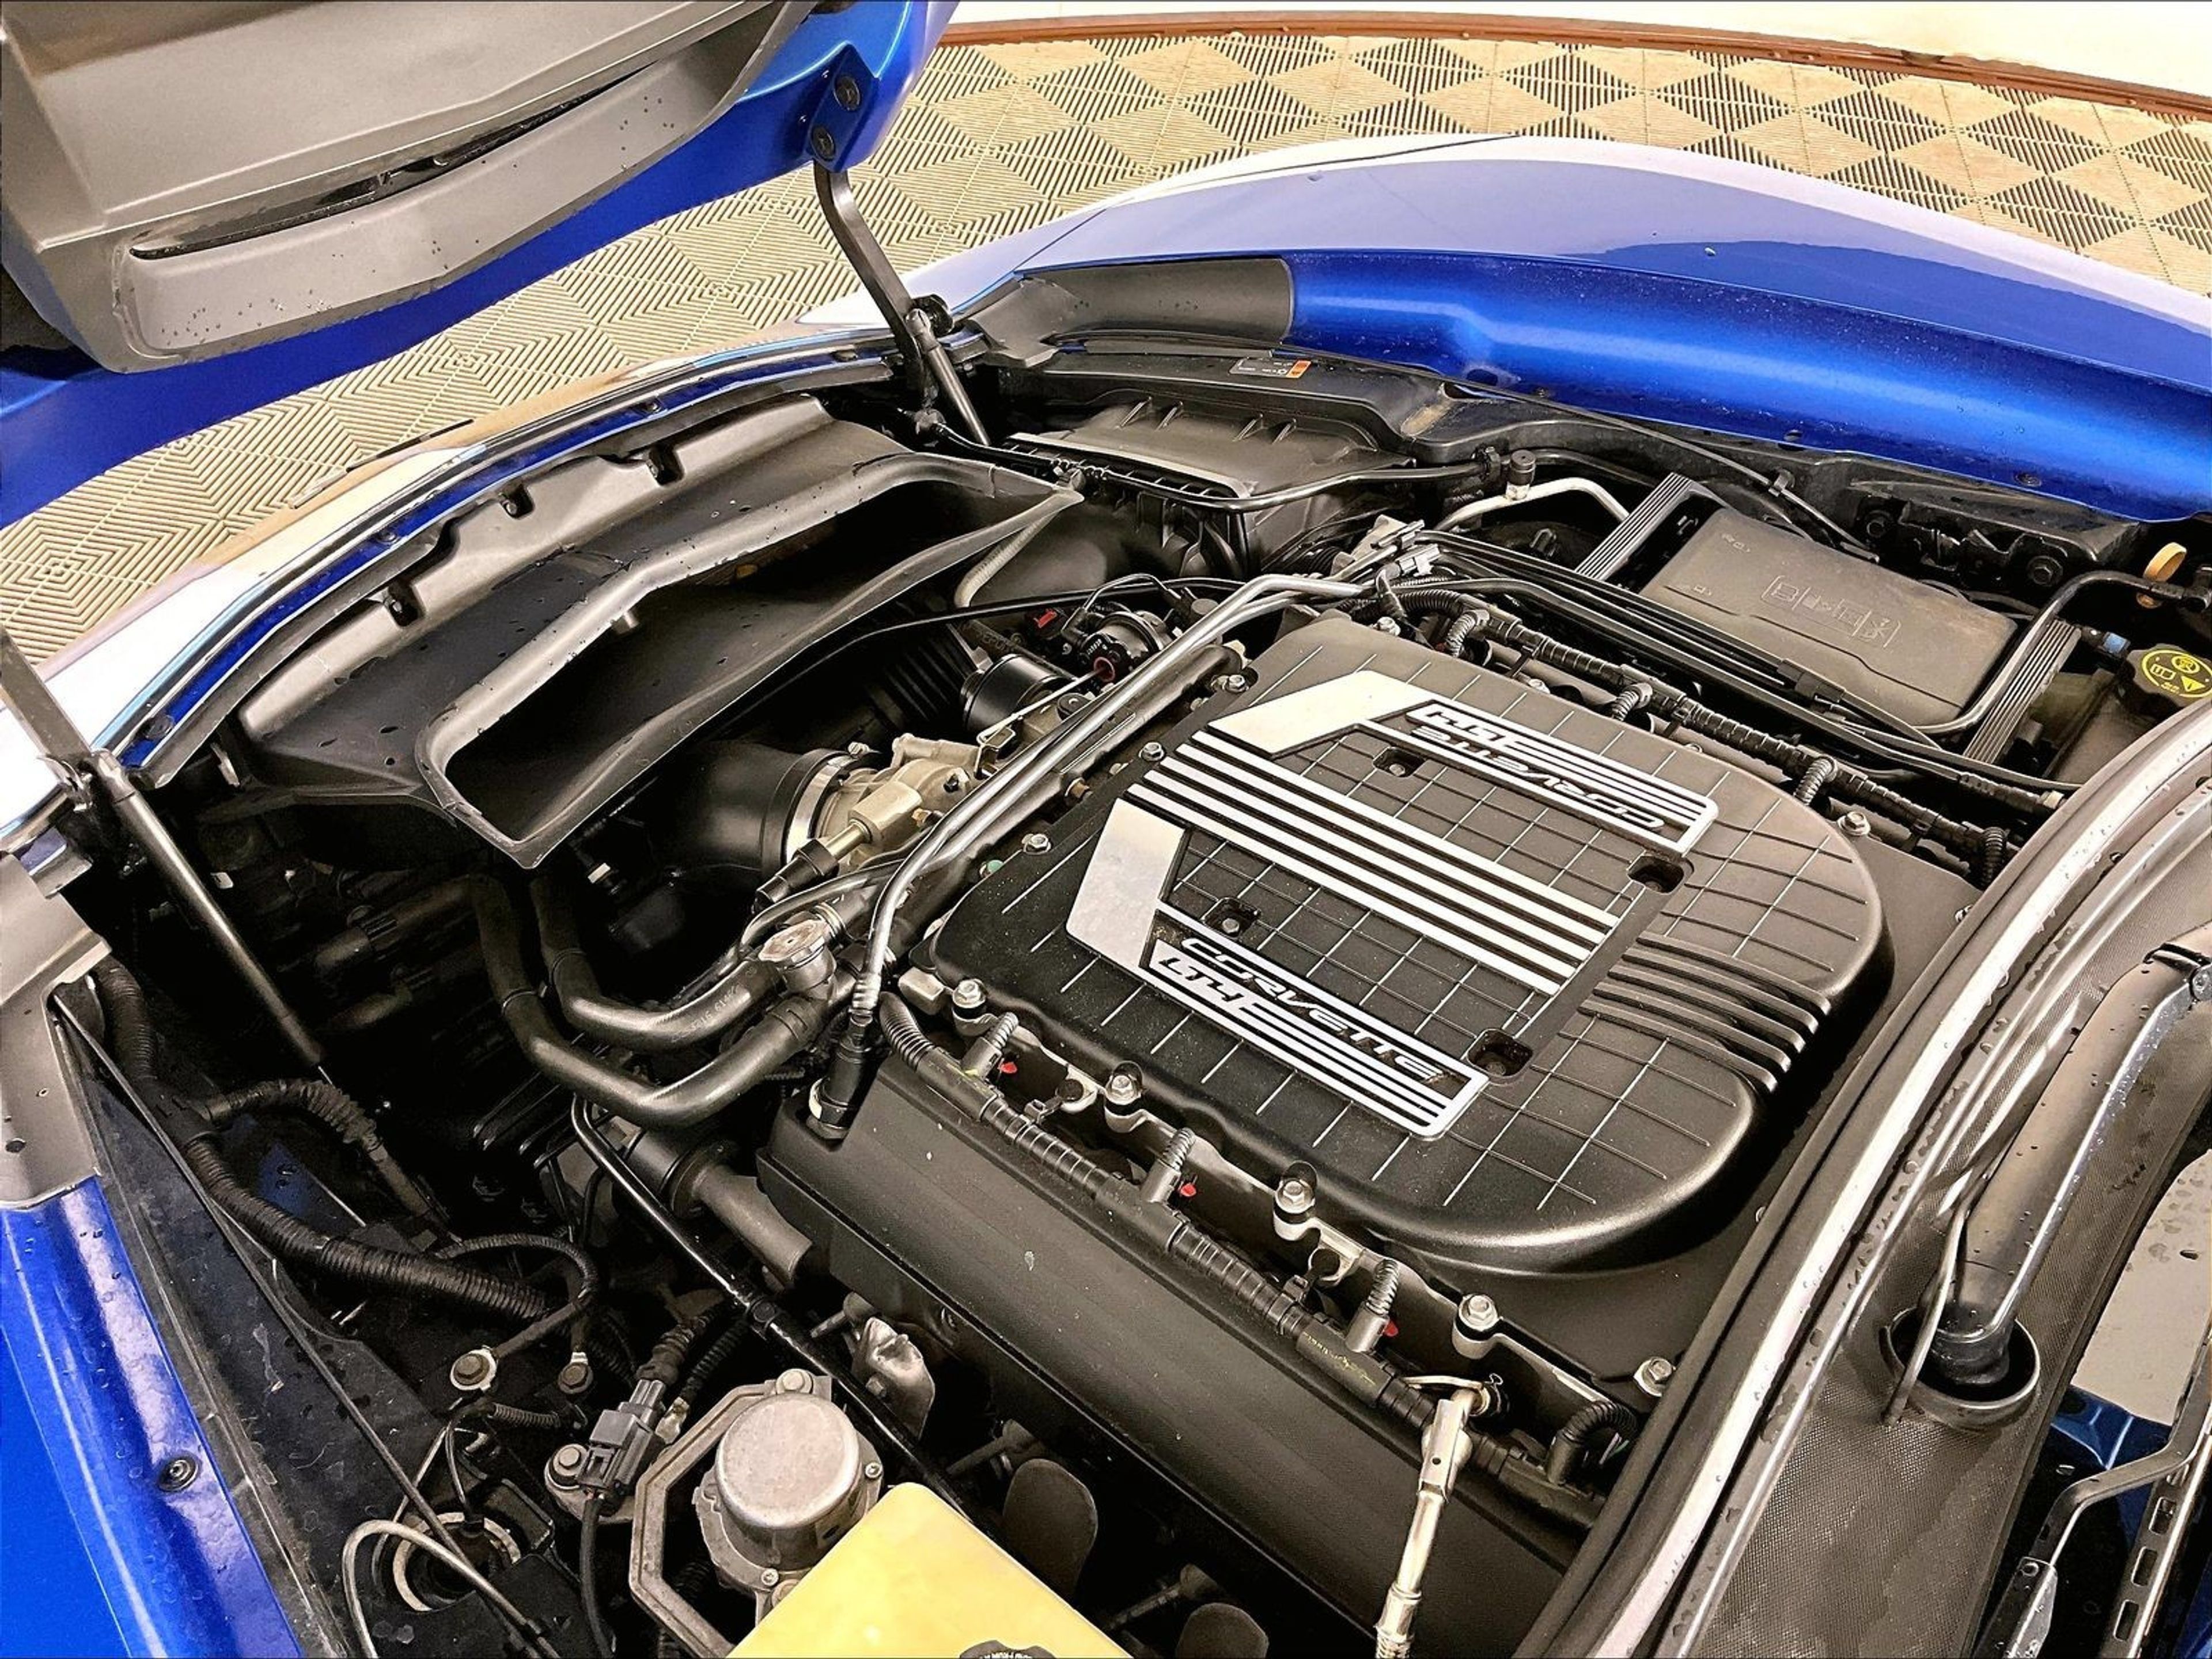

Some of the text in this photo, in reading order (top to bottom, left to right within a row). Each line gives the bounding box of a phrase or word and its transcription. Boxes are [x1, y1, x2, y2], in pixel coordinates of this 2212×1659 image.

[1426, 711, 1507, 742] LT4
[1411, 725, 1666, 830] CORVETTE
[1158, 957, 1245, 1002] LT4
[1181, 938, 1446, 1081] CORVETTE
